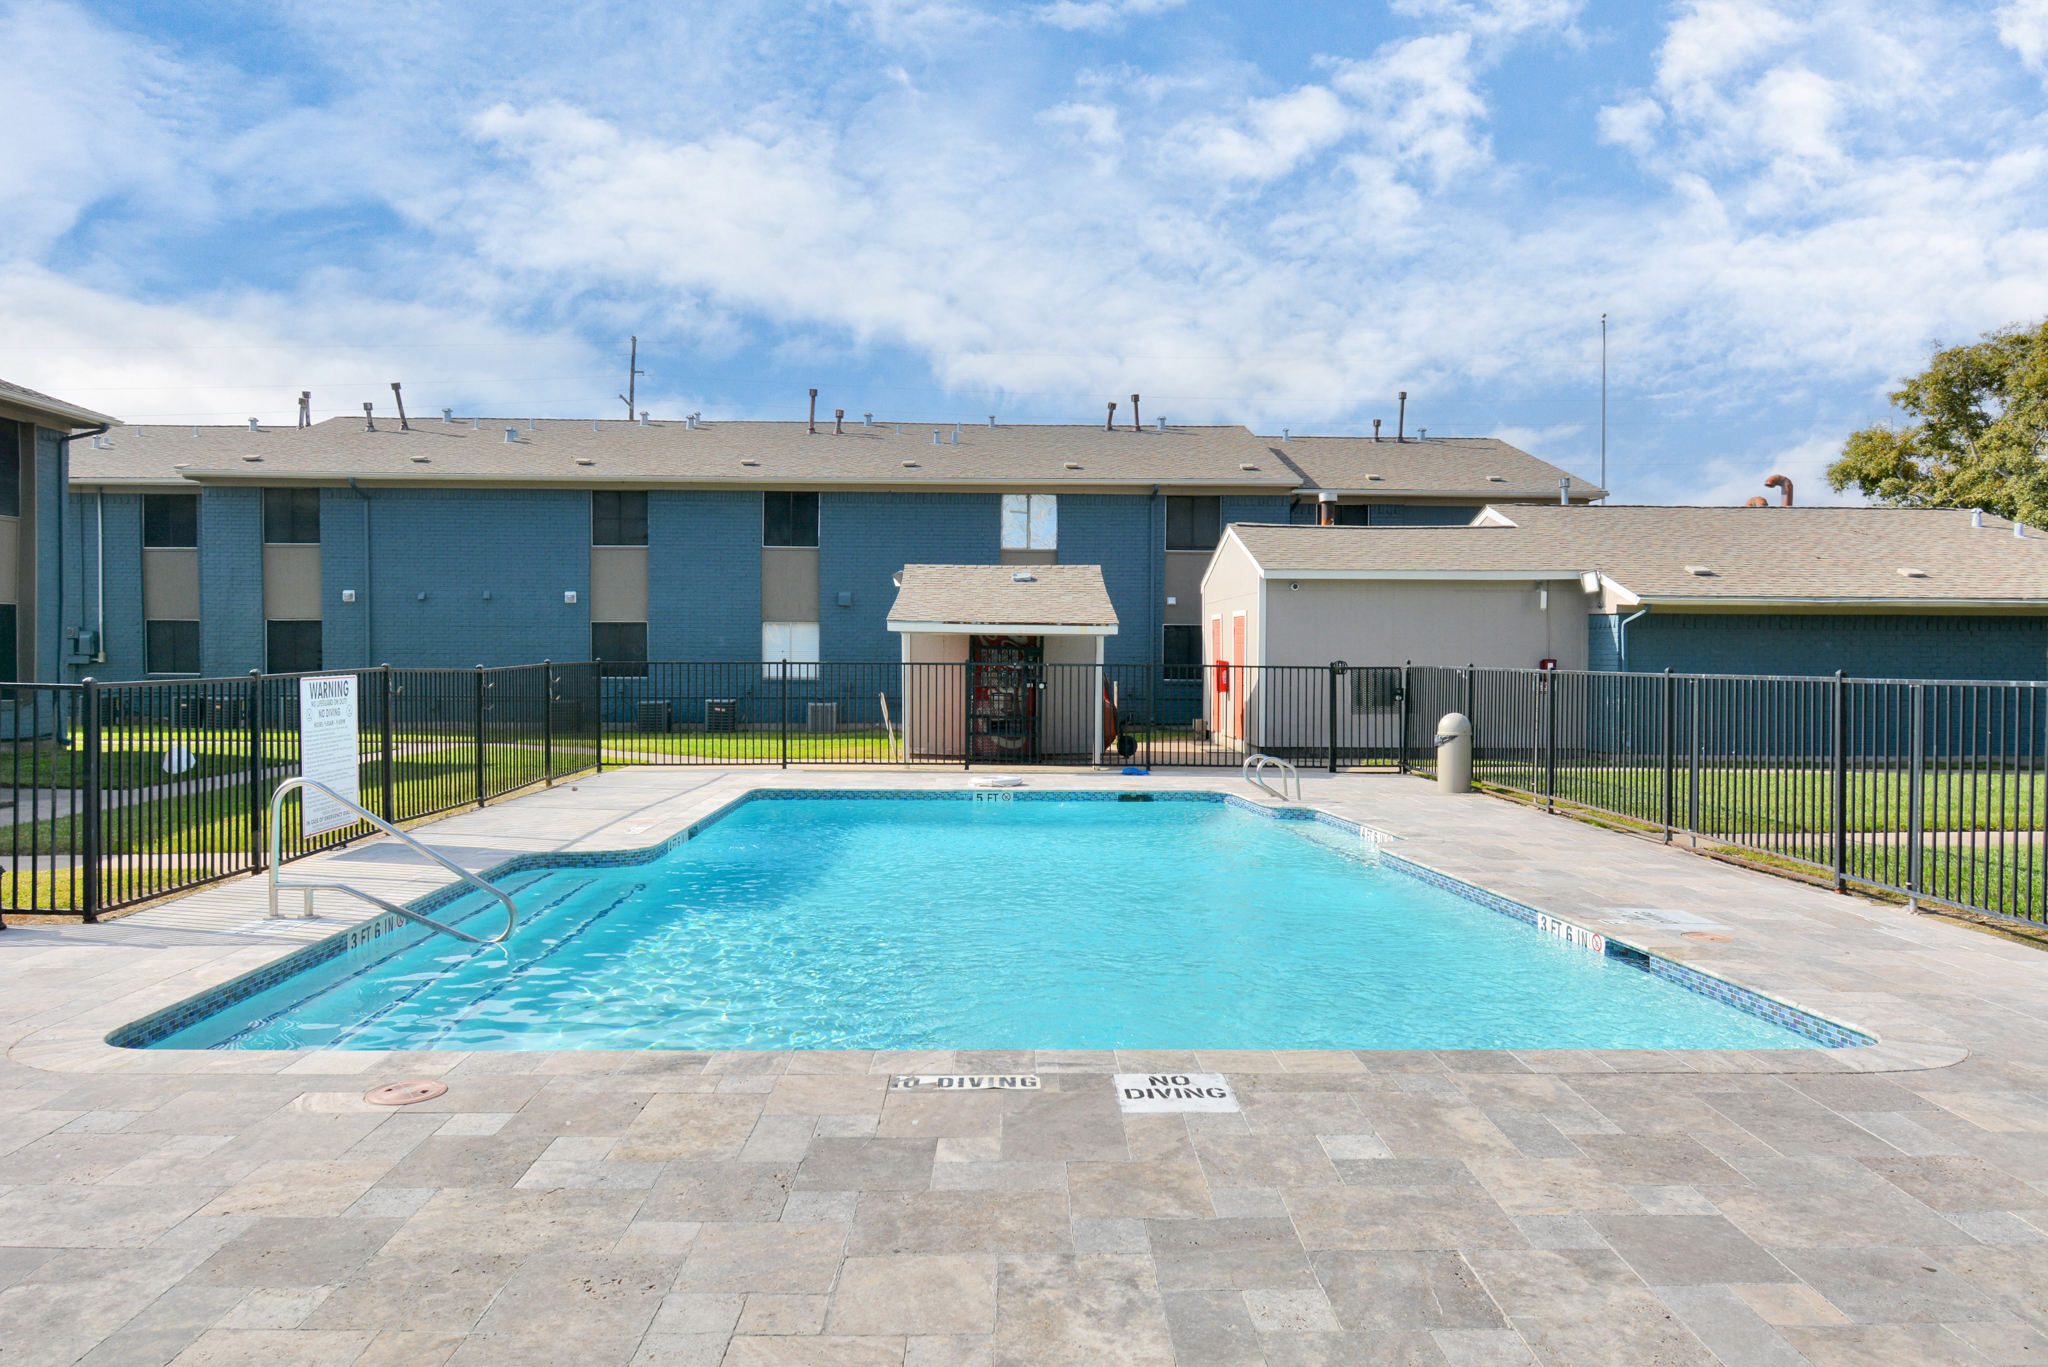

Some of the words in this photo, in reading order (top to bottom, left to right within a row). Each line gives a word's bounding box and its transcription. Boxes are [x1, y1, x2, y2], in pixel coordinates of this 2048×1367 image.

[309, 680, 349, 699] WARNING
[319, 709, 325, 718] NO
[326, 708, 340, 717] DIVING
[987, 793, 998, 802] FT
[351, 932, 358, 949] 3
[361, 925, 371, 945] FT
[374, 922, 381, 939] 6
[385, 916, 393, 934] IN
[1541, 916, 1547, 931] 3
[1551, 919, 1562, 937] FT
[1566, 925, 1573, 942] 6
[1578, 930, 1587, 948] IN
[937, 1077, 1037, 1088] DIVING
[1148, 1075, 1191, 1086] NO
[1124, 1087, 1227, 1100] DIVING
